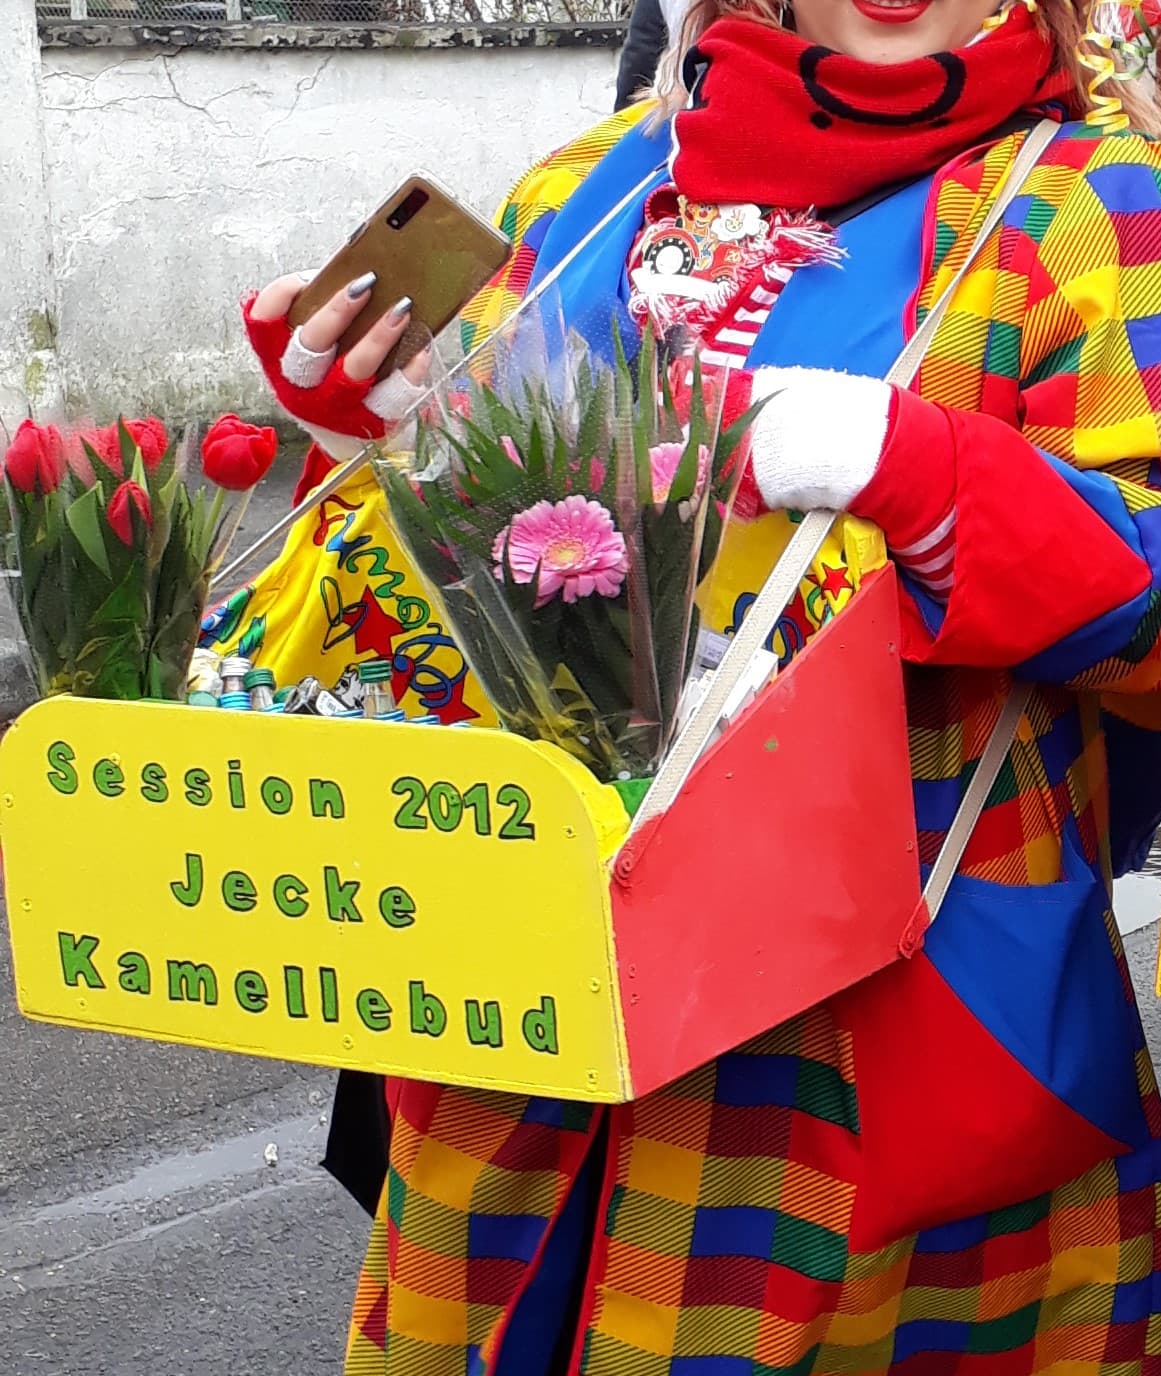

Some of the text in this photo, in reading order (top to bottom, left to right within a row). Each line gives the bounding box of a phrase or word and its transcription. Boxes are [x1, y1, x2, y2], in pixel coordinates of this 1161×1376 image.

[47, 740, 535, 840] Session 2012
[170, 853, 416, 929] Jecke
[58, 931, 559, 1055] Kamellebud
